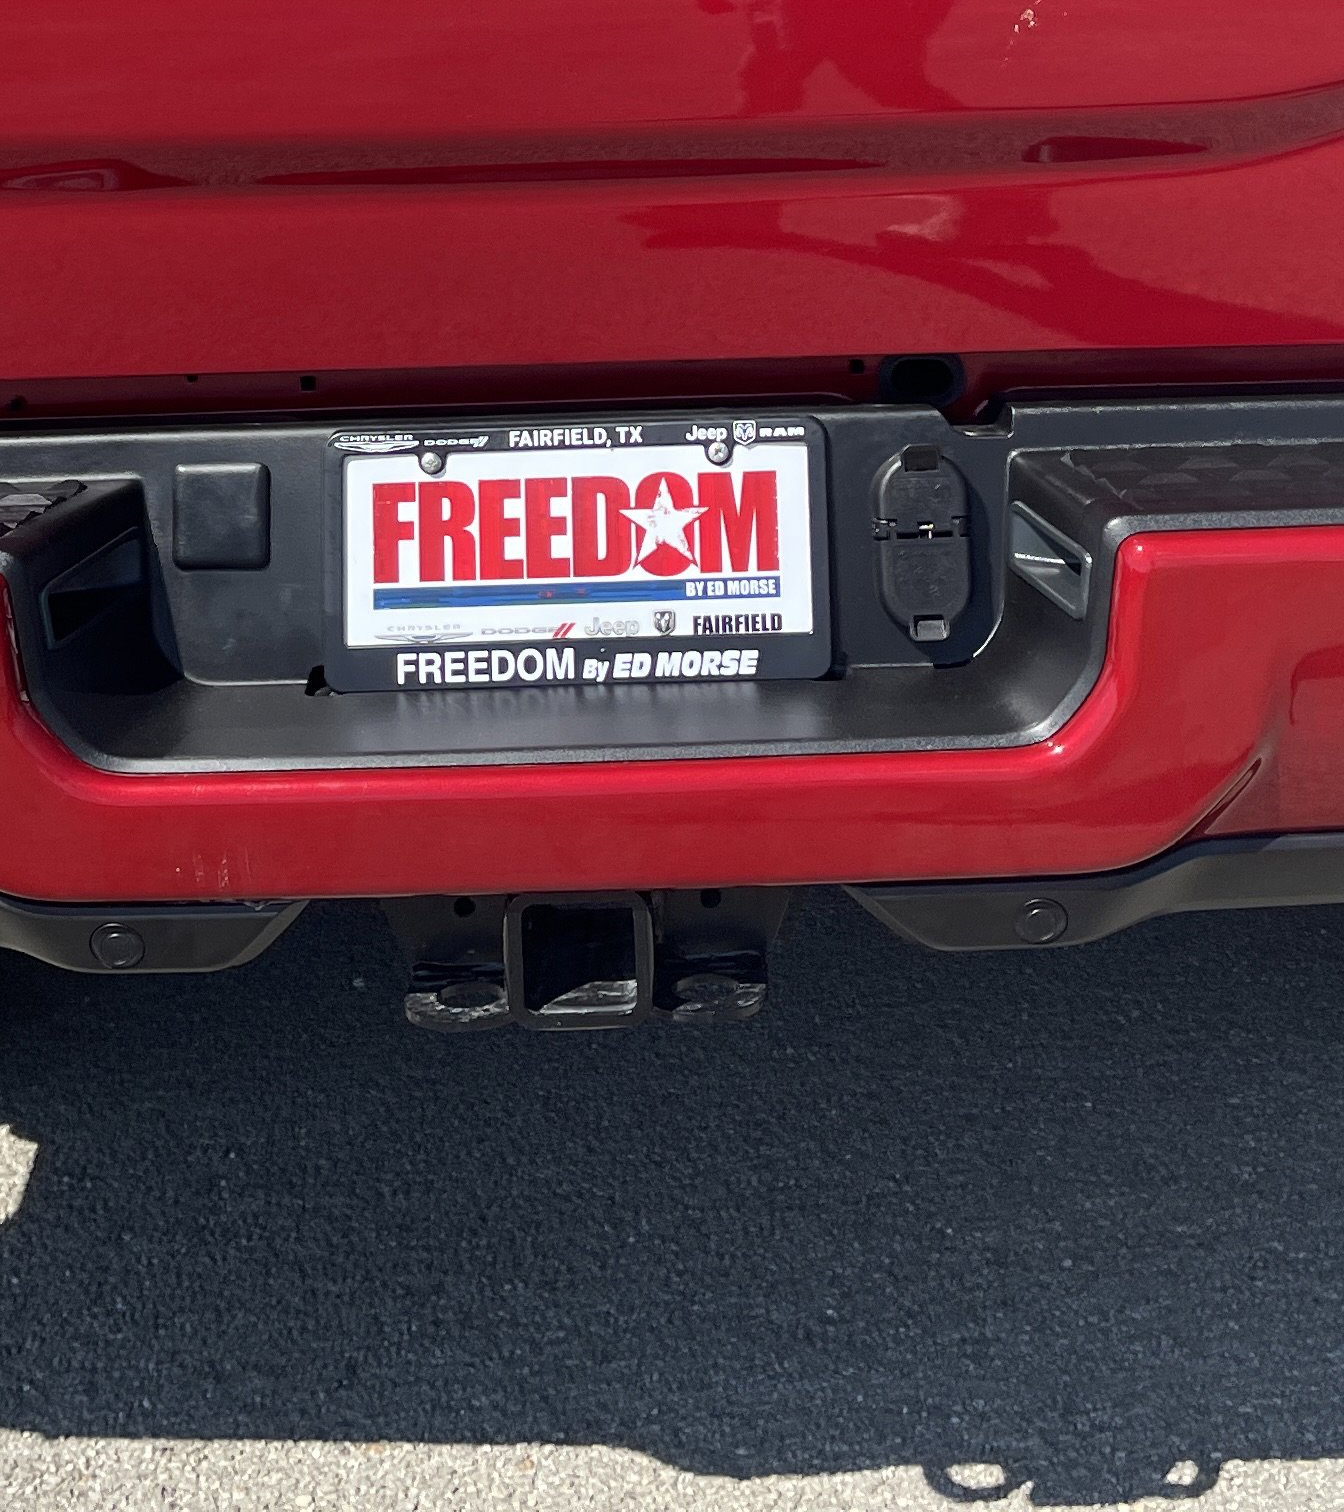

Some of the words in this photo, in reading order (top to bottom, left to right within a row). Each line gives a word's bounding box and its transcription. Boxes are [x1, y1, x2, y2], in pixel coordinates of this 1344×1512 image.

[339, 434, 414, 442] CHRYSLER
[509, 428, 612, 448] FAIRFIELD,
[616, 426, 642, 444] TX
[685, 425, 727, 441] Jeep
[759, 426, 805, 437] RAM
[373, 471, 779, 584] FREEDOM
[685, 580, 704, 596] BY
[707, 580, 724, 596] ED
[727, 578, 776, 596] MORSE
[387, 624, 461, 632] CHRYSLER
[481, 626, 557, 636] DODGE
[584, 617, 640, 637] Jeep
[692, 613, 783, 635] FAIRFIELD
[396, 647, 575, 685] FREEDOM
[582, 658, 609, 682] By
[612, 652, 652, 679] ED
[655, 649, 760, 678] MORSE
